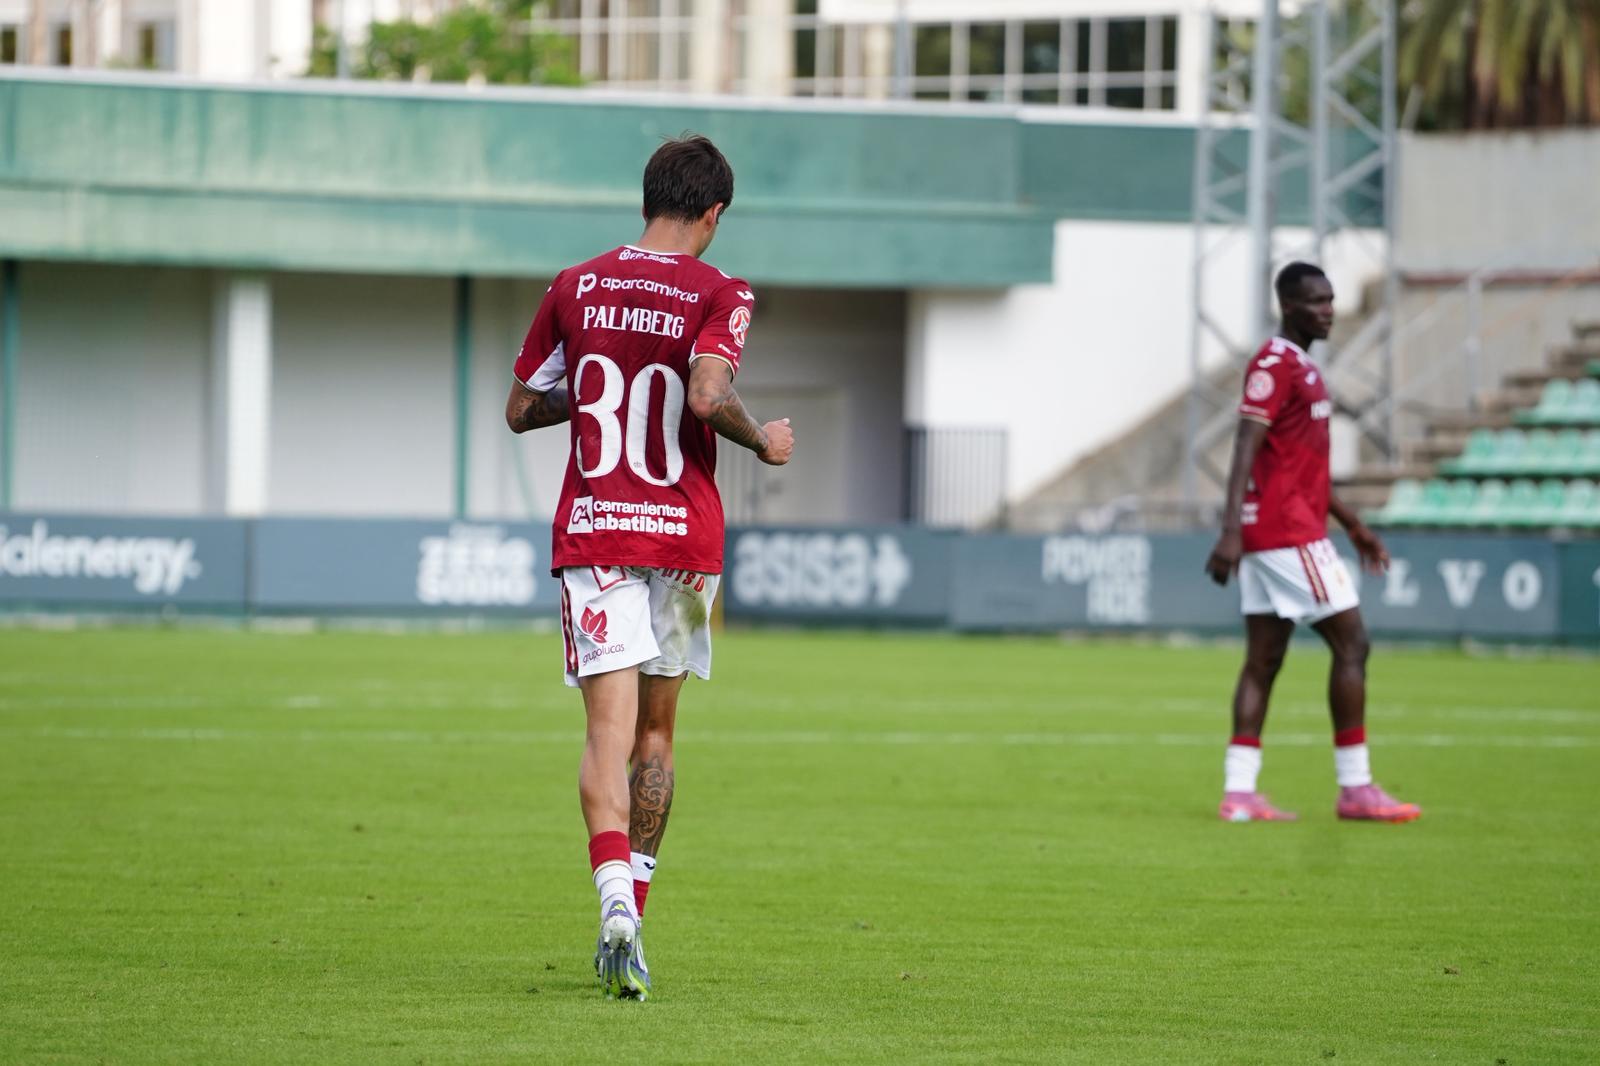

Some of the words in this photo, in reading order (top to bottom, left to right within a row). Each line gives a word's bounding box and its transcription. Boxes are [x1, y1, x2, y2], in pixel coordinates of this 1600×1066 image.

[600, 277, 699, 303] aparcamurcia
[582, 305, 685, 339] PALMBERG
[573, 353, 685, 487] 30
[593, 500, 687, 519] cerramientos
[593, 513, 688, 535] abatibles
[733, 532, 871, 607] asisa
[1345, 557, 1543, 611] LVO
